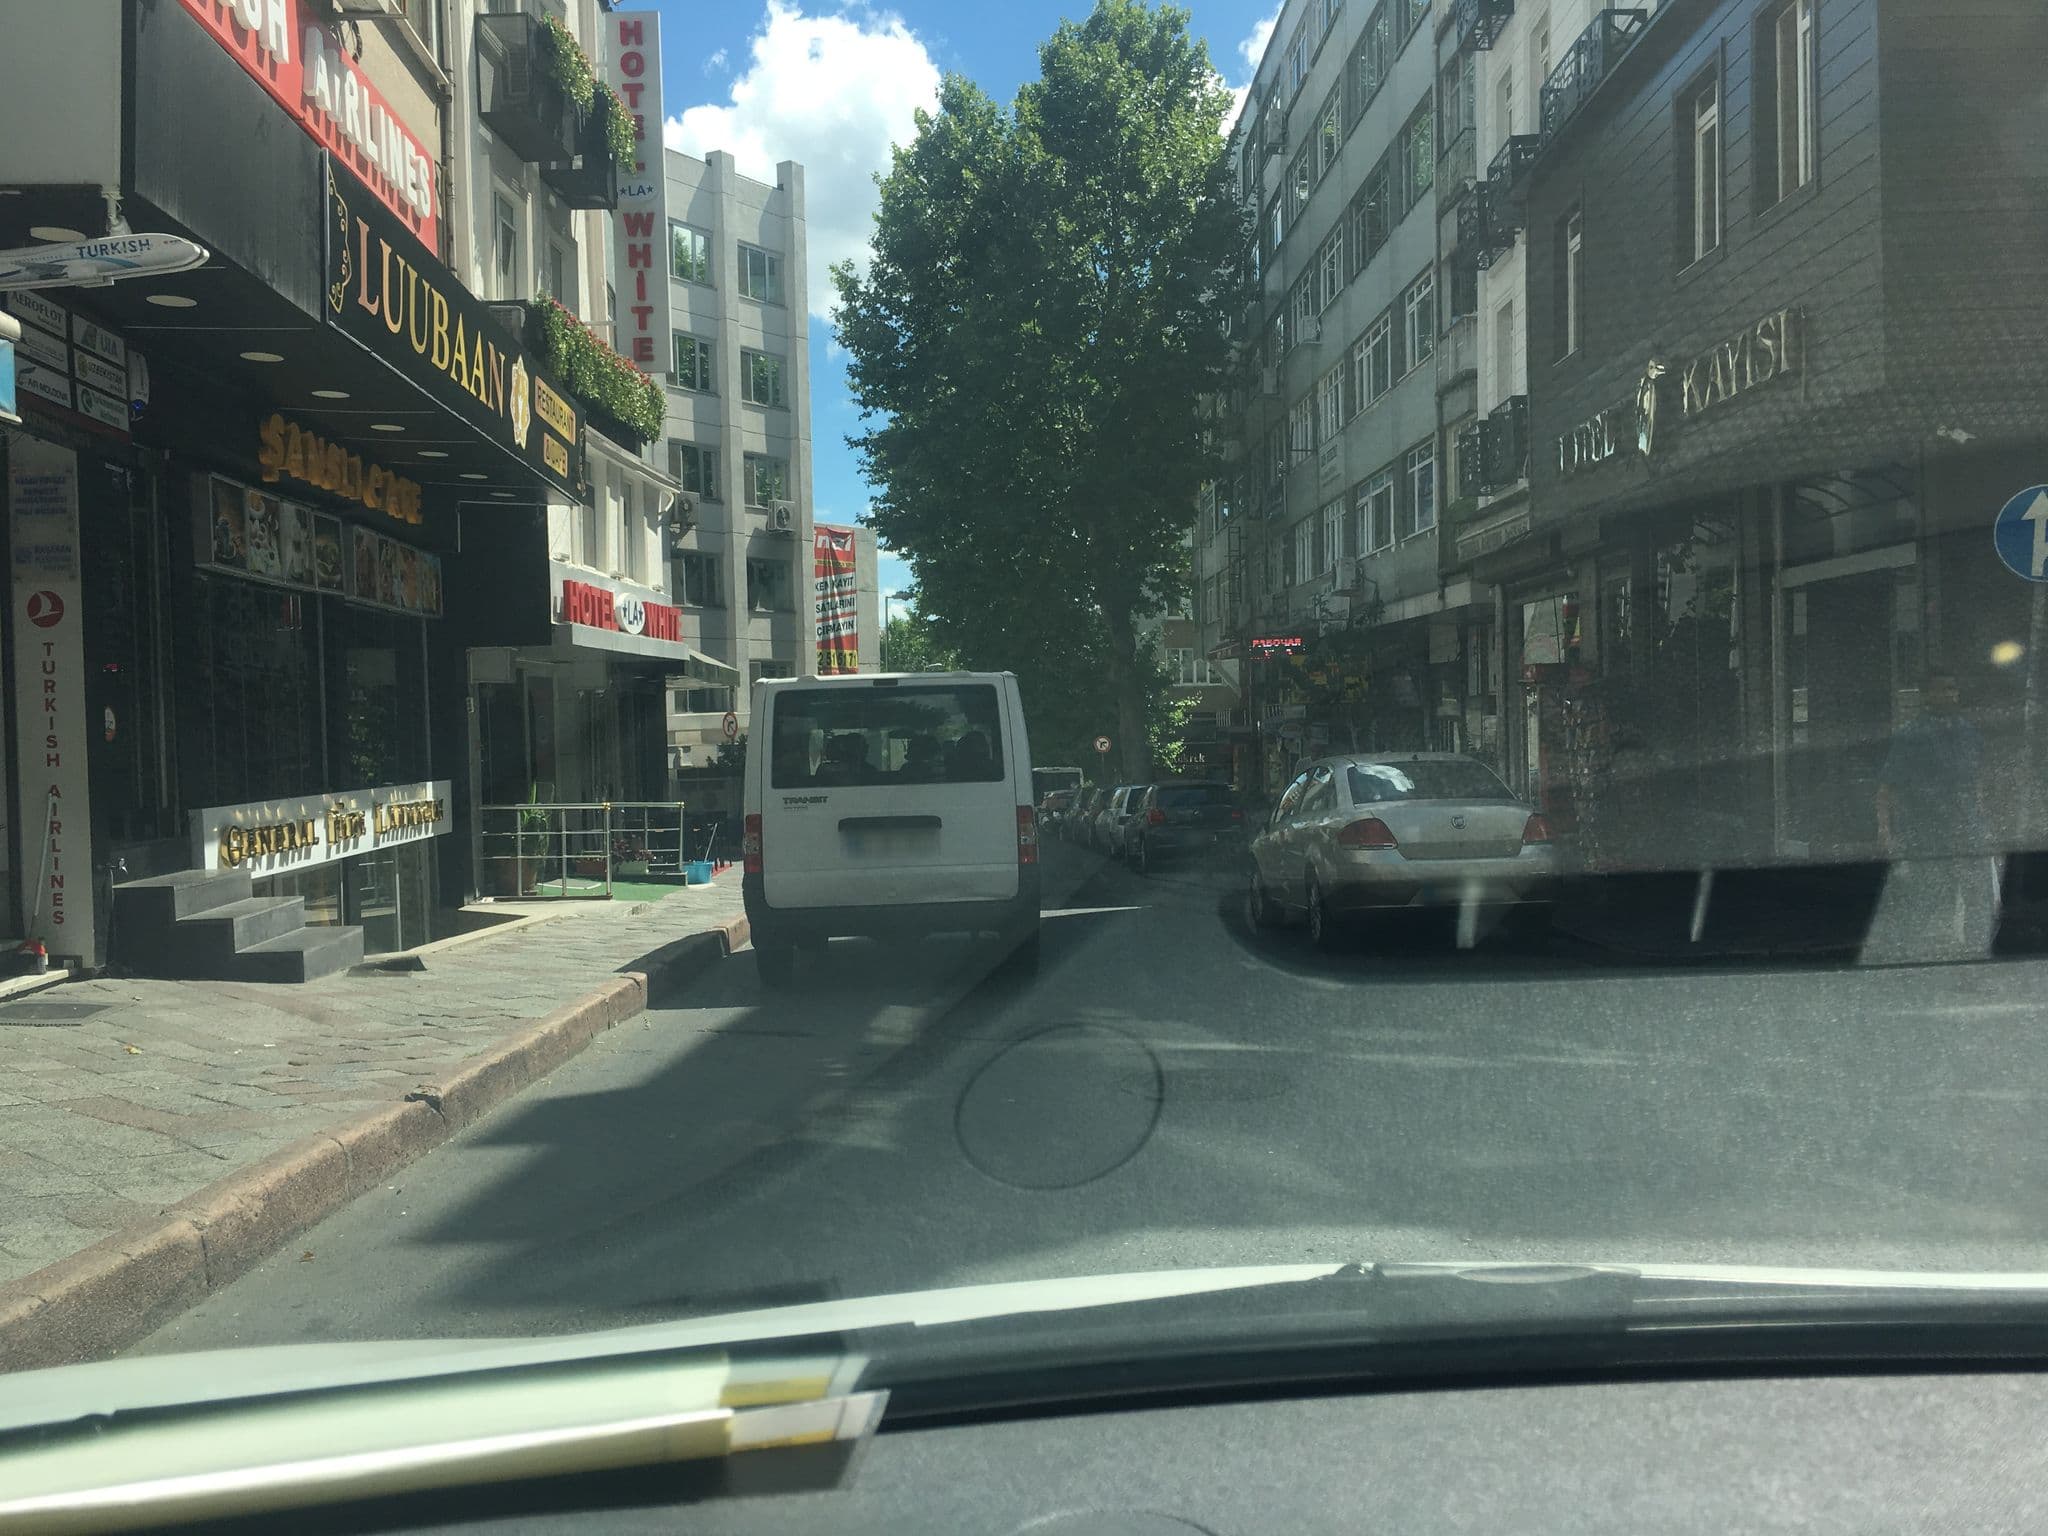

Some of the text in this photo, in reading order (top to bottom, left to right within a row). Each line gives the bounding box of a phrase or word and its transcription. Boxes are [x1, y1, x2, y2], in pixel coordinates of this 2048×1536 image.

[306, 42, 431, 219] AIRLINES
[620, 19, 655, 362] HOTE LA WHITE
[76, 239, 151, 259] TURKISH
[357, 216, 505, 418] LUUBAAN
[563, 580, 683, 643] HOTEL LA WHITE
[41, 642, 64, 925] TURKISH AIRLINES
